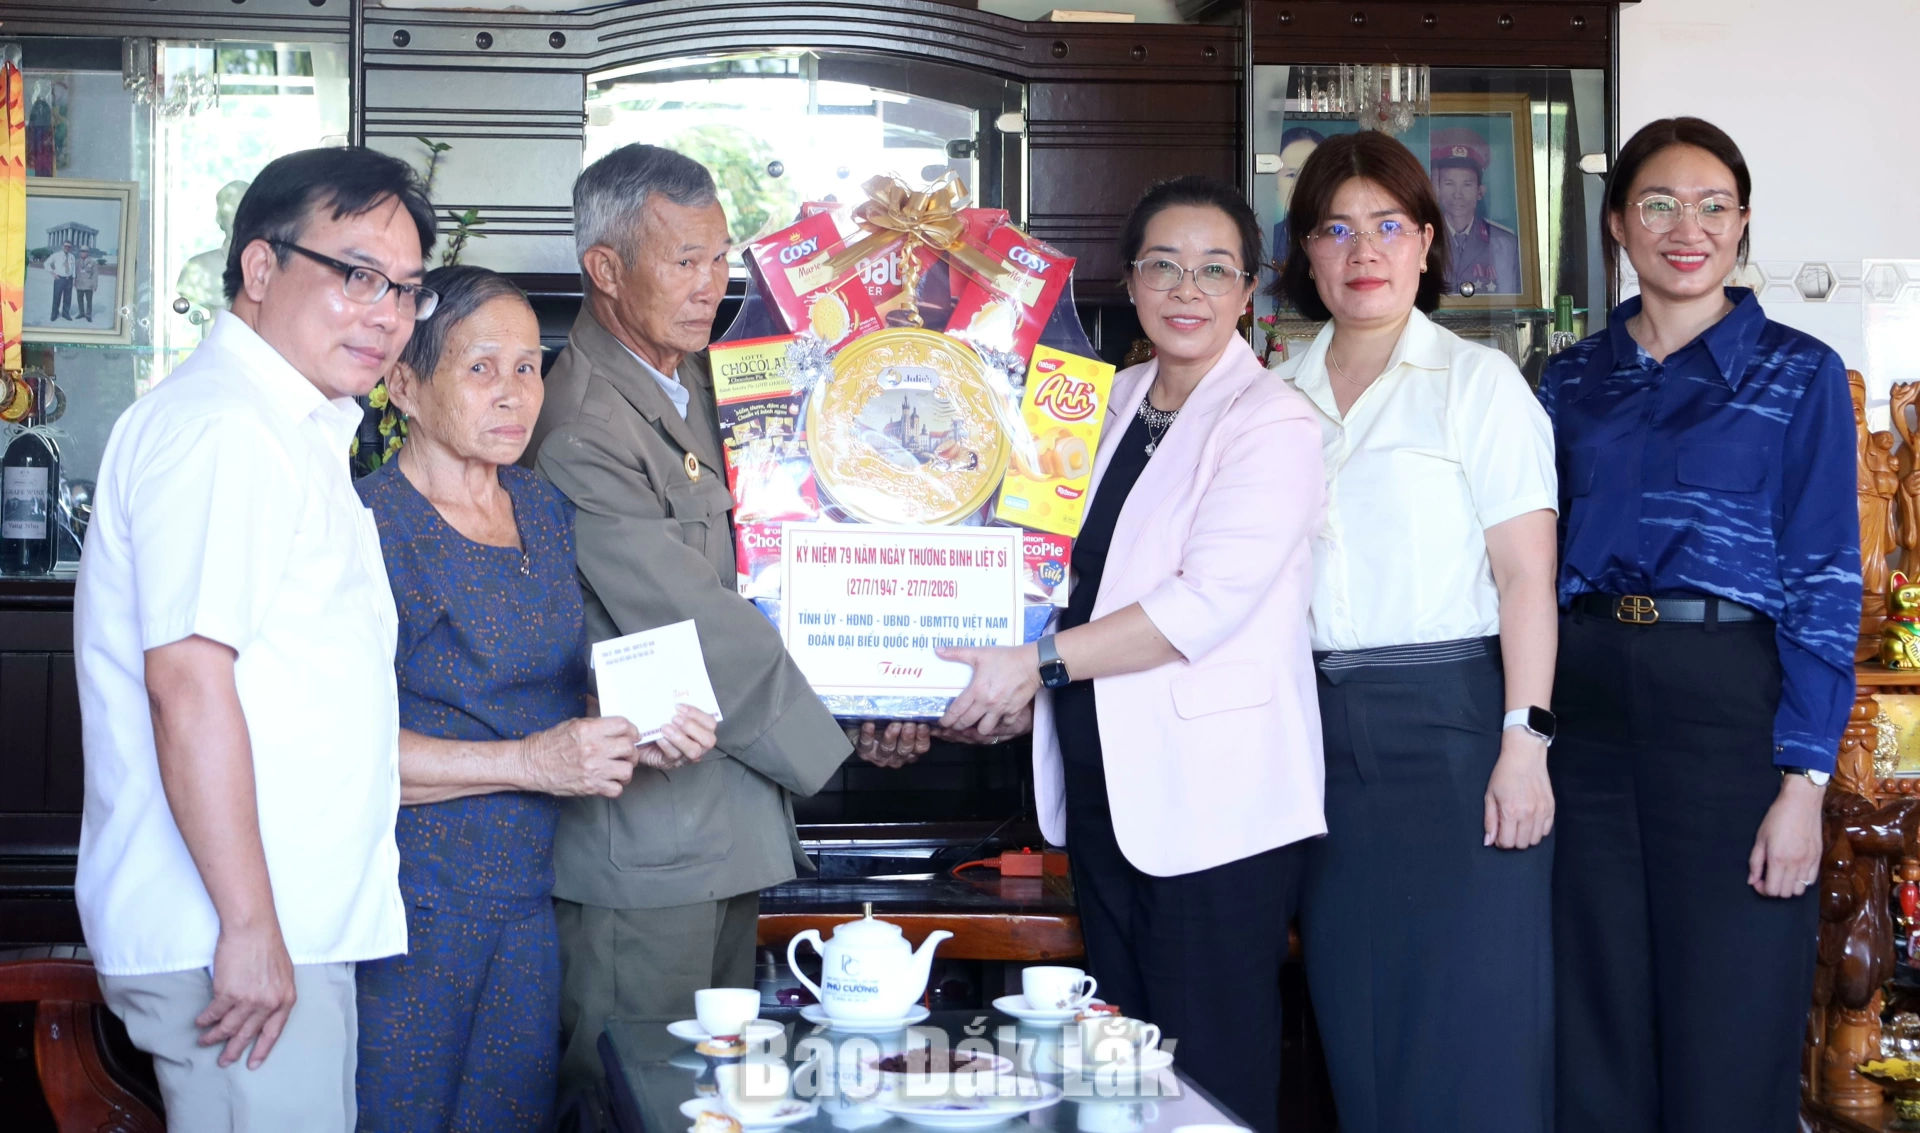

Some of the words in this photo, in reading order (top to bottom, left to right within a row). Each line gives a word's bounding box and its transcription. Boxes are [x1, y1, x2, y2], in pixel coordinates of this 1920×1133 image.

[780, 236, 818, 265] COSY
[1008, 246, 1050, 273] COSY
[1007, 270, 1032, 288] Maie
[904, 374, 932, 384] Julie's
[796, 539, 809, 564] KỶ
[812, 542, 837, 568] NIỆM
[840, 547, 852, 564] 79
[854, 543, 877, 565] NĂM
[880, 544, 906, 566] NGÀY
[909, 546, 946, 567] THƯƠNG
[949, 549, 973, 567] BINH
[975, 546, 995, 571] LIỆT
[997, 546, 1008, 568] SĨ
[847, 578, 898, 597] (27/7/1947
[907, 579, 958, 599] 27/7/2026)
[799, 609, 821, 625] TỈNH
[824, 609, 836, 625] ỦY
[846, 614, 873, 627] HĐND
[883, 615, 910, 627] UBND
[920, 615, 959, 629] UBMTTQ
[962, 613, 983, 632] VIỆT
[985, 616, 1008, 629] NAM
[808, 631, 835, 647] ĐOÀN
[838, 634, 854, 650] ĐẠI
[857, 629, 880, 648] BIỂU
[883, 631, 909, 649] QUỐC
[912, 633, 929, 651] HỘI
[877, 661, 923, 679] Tặng
